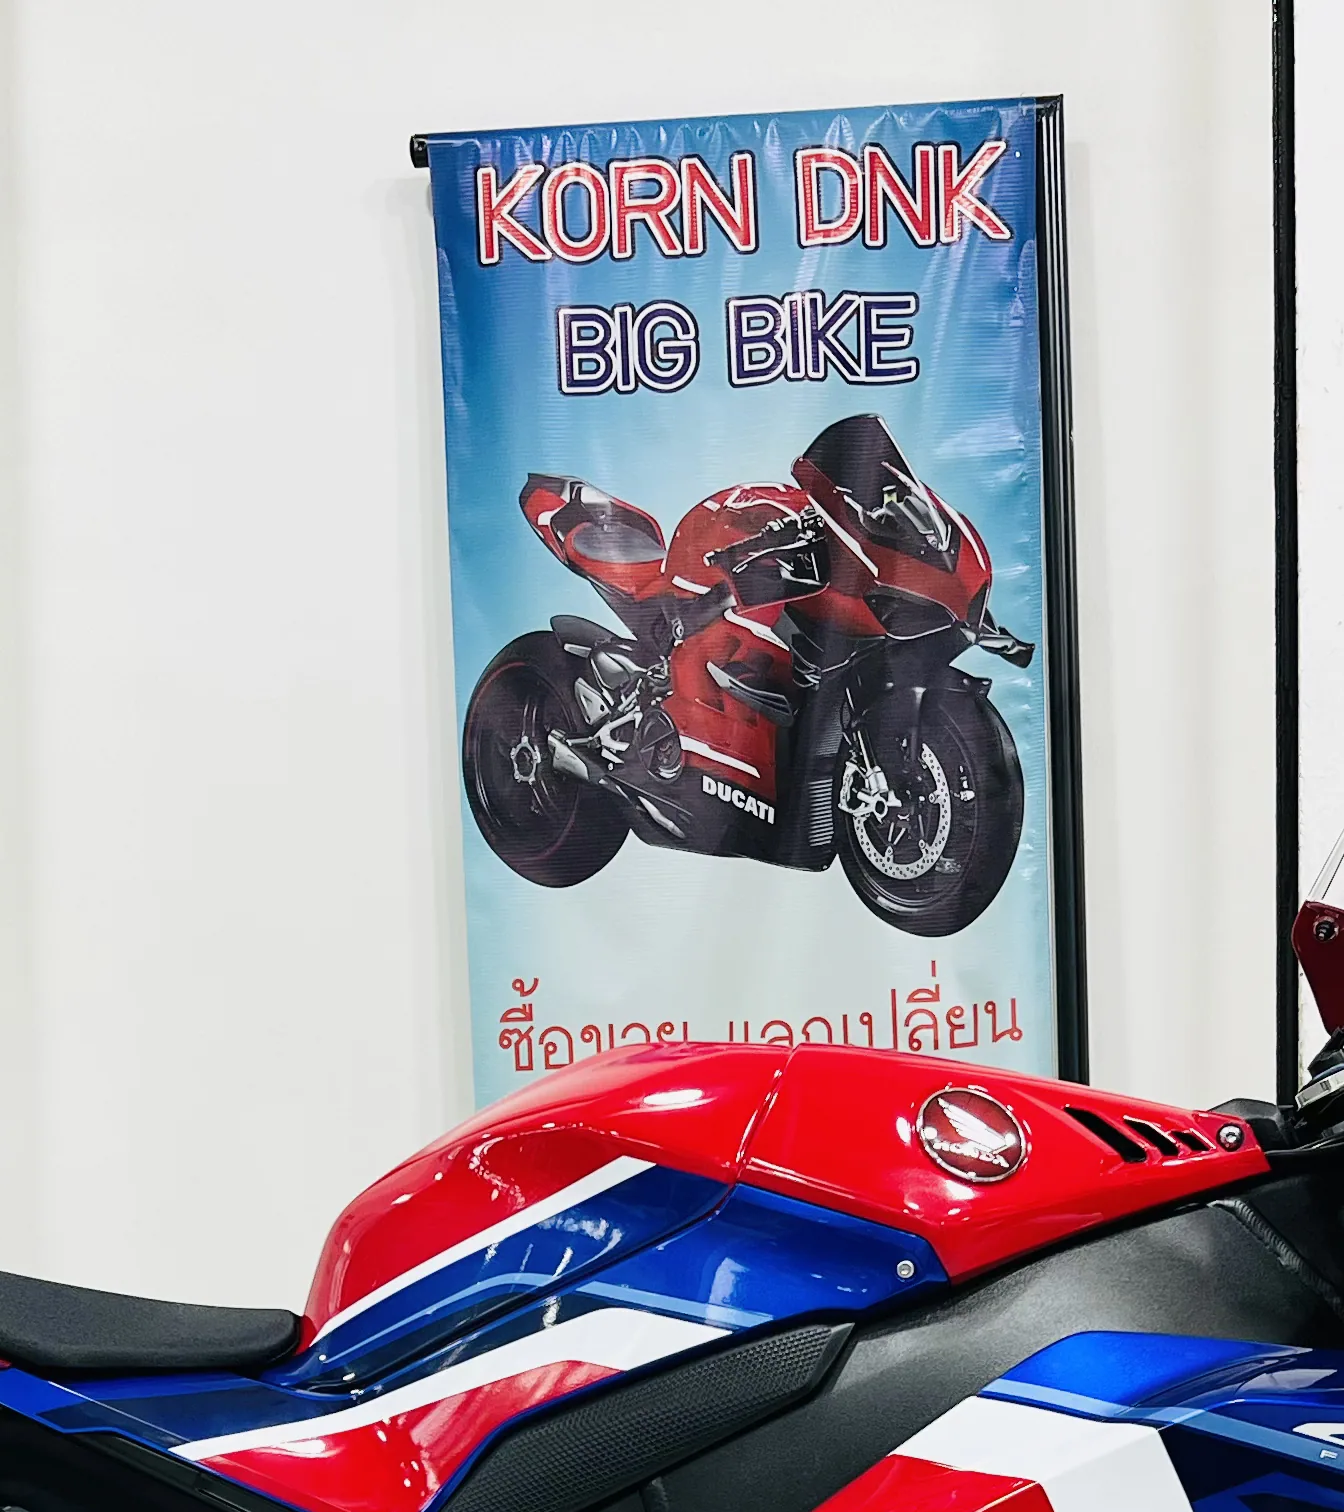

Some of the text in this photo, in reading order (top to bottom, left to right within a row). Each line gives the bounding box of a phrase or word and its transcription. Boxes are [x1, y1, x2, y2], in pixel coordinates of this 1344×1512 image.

[477, 139, 1011, 264] KORN DNK
[557, 291, 919, 394] BIG BIKE
[702, 775, 775, 825] DUCATI
